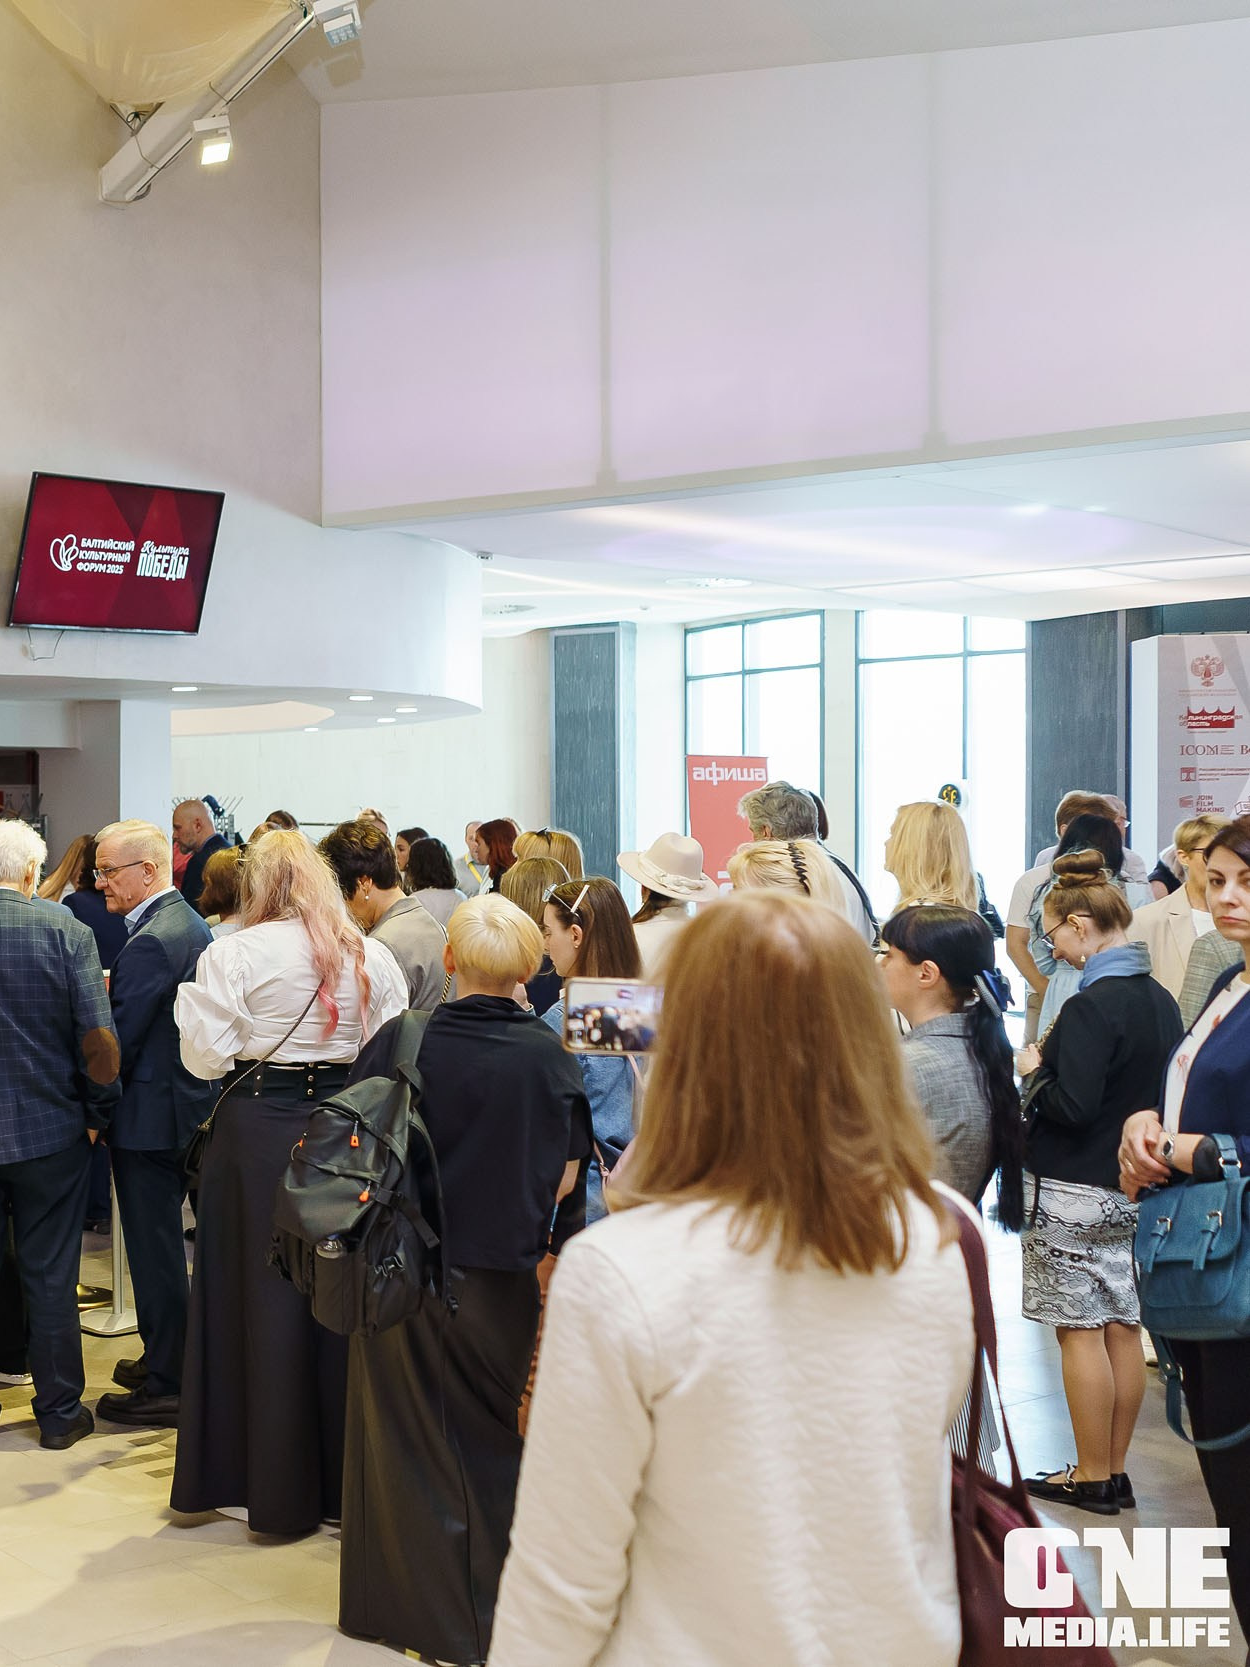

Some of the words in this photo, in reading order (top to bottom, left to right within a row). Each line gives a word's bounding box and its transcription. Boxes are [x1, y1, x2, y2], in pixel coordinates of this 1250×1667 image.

[81, 538, 134, 551] БАЛТИЙСКИЙ
[141, 540, 189, 561] Культура
[79, 551, 130, 562] КУЛЬТУРНЫЙ
[77, 563, 106, 573] ФОРУМ
[107, 564, 124, 574] 2025
[136, 553, 189, 580] ПОБЕДЫ
[1180, 745, 1218, 755] ICOM
[692, 762, 766, 786] афиша
